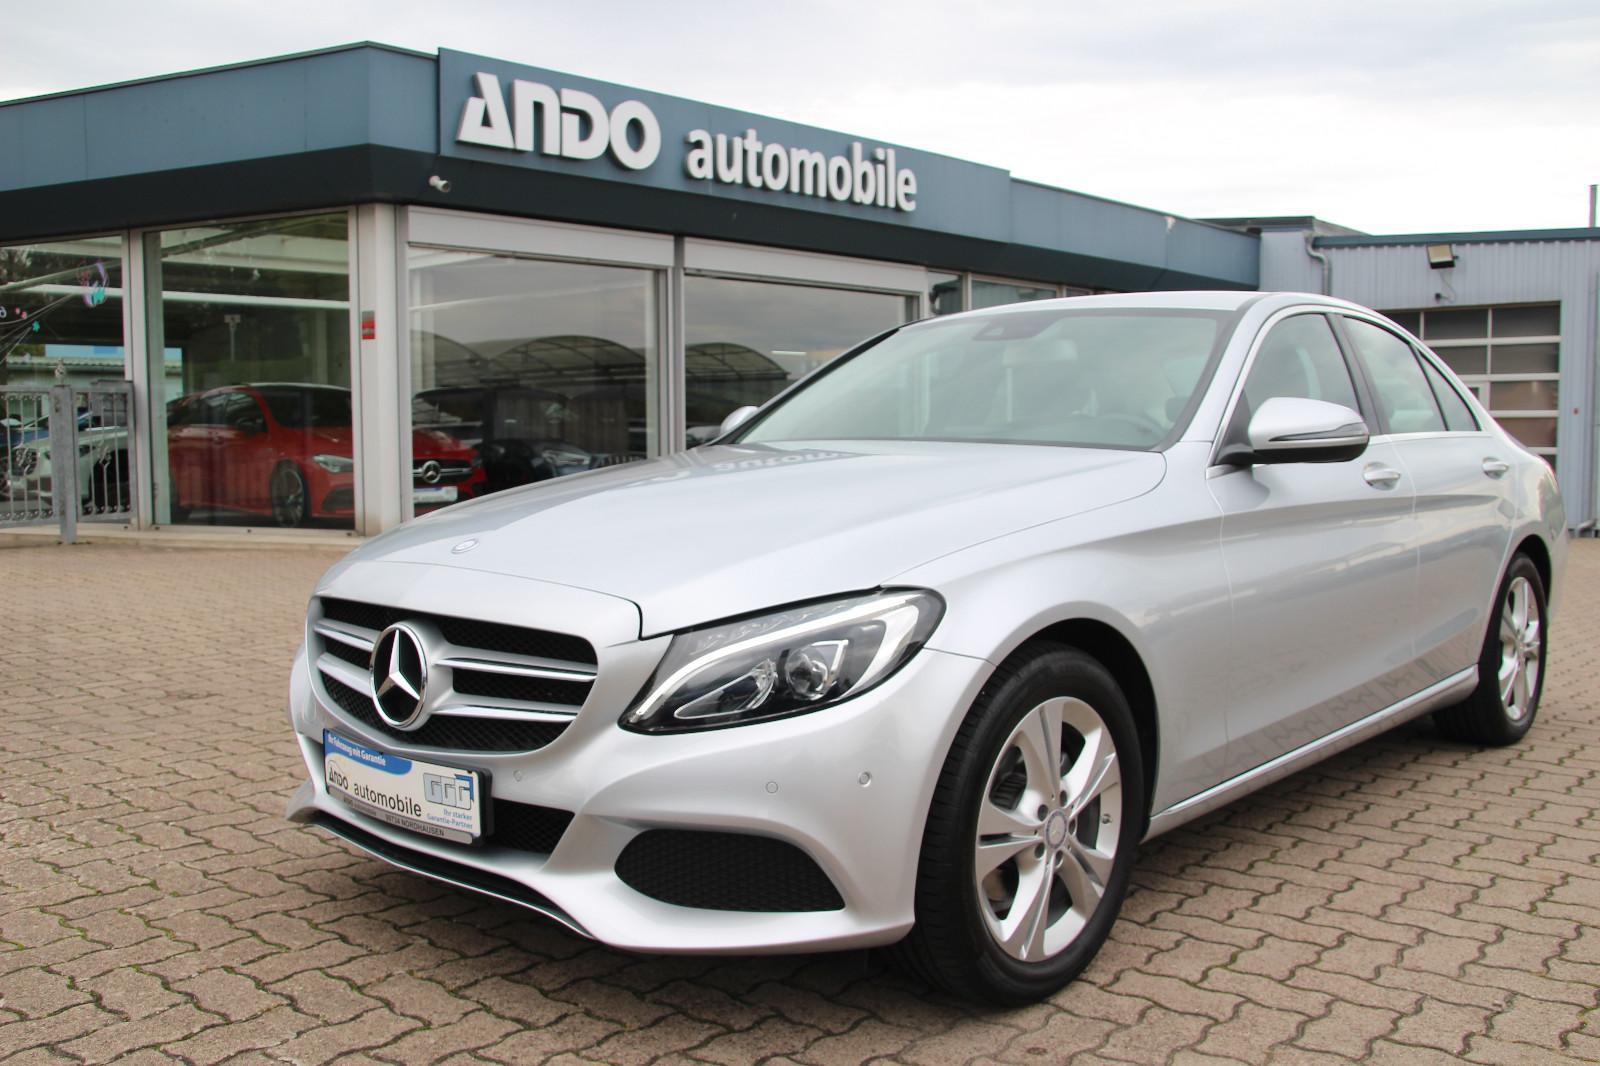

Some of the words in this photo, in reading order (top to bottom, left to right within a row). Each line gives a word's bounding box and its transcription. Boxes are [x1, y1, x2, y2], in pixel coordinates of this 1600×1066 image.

[455, 72, 662, 170] ANDO
[684, 128, 917, 213] automobile
[353, 783, 422, 817] automobile
[401, 817, 445, 837] NORDHAUSEN
